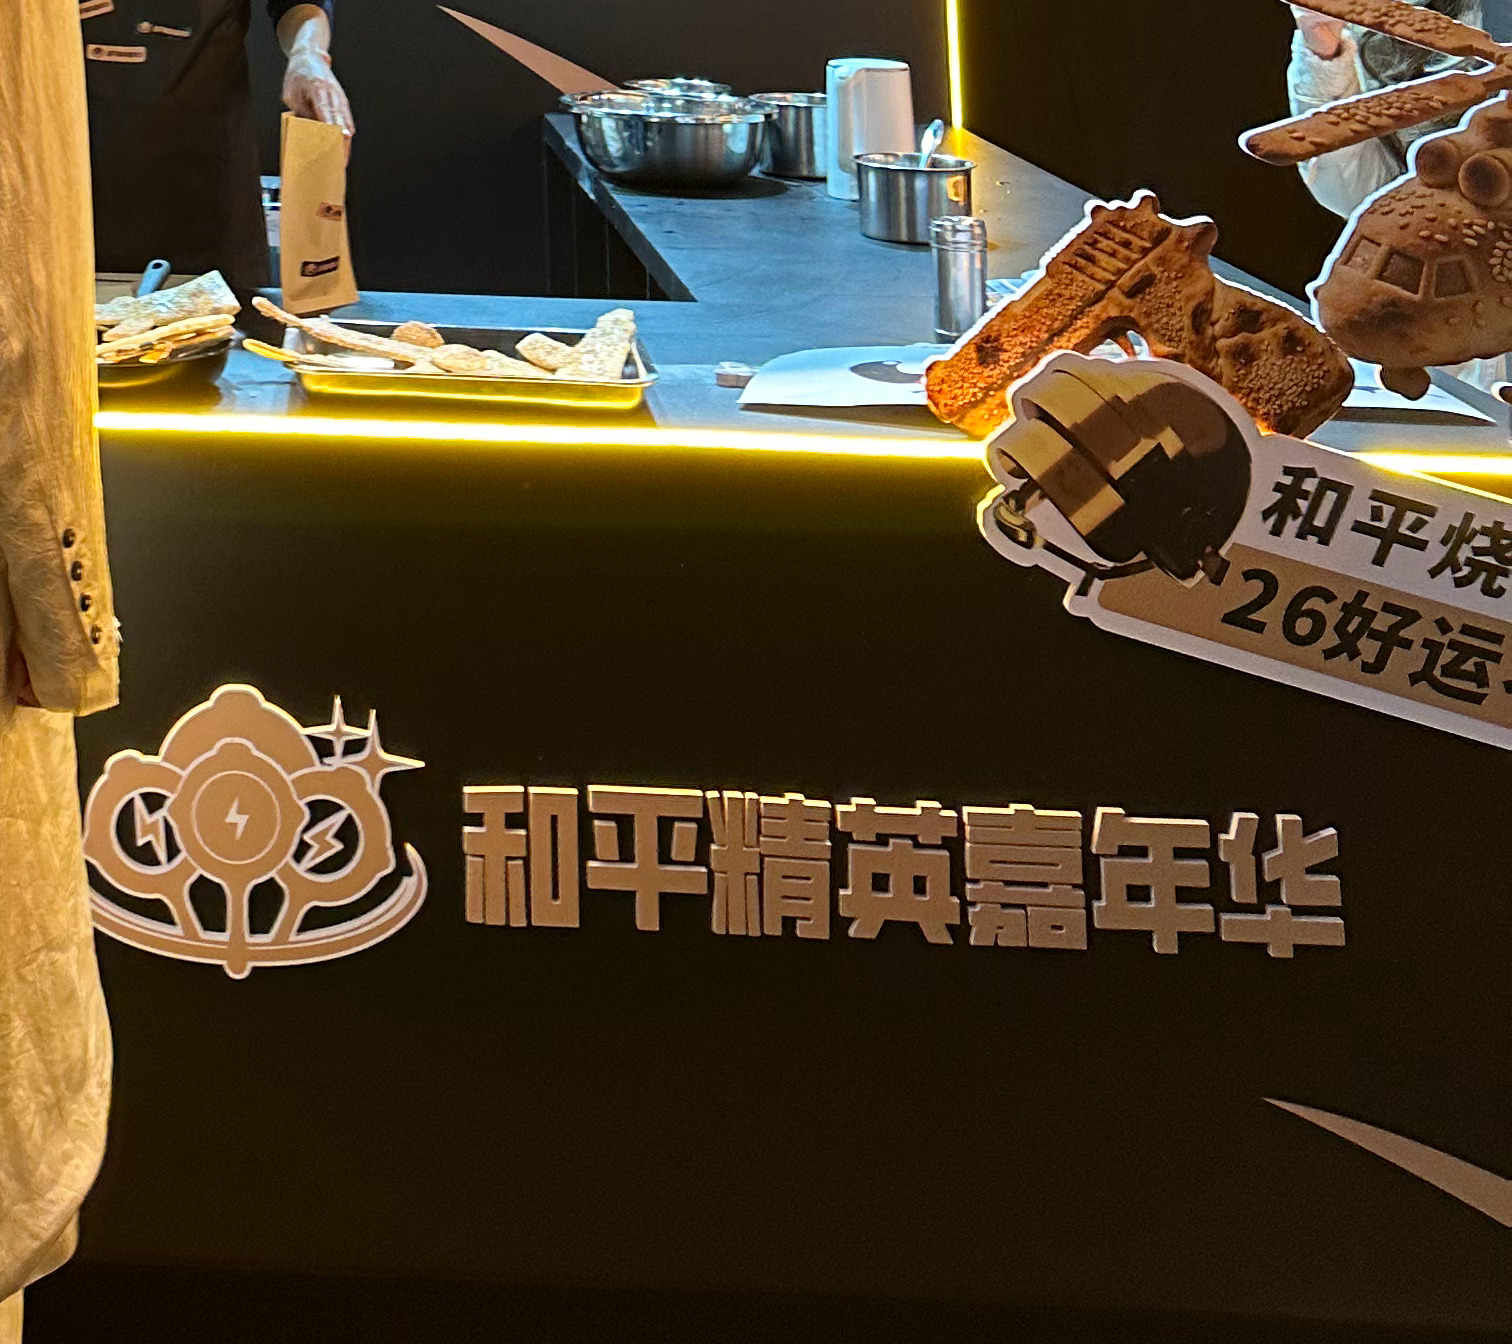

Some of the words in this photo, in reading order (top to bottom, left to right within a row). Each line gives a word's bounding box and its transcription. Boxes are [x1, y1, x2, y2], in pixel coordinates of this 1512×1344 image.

[1220, 569, 1512, 706] 26好运
[461, 783, 1346, 959] 和平精英嘉年华
